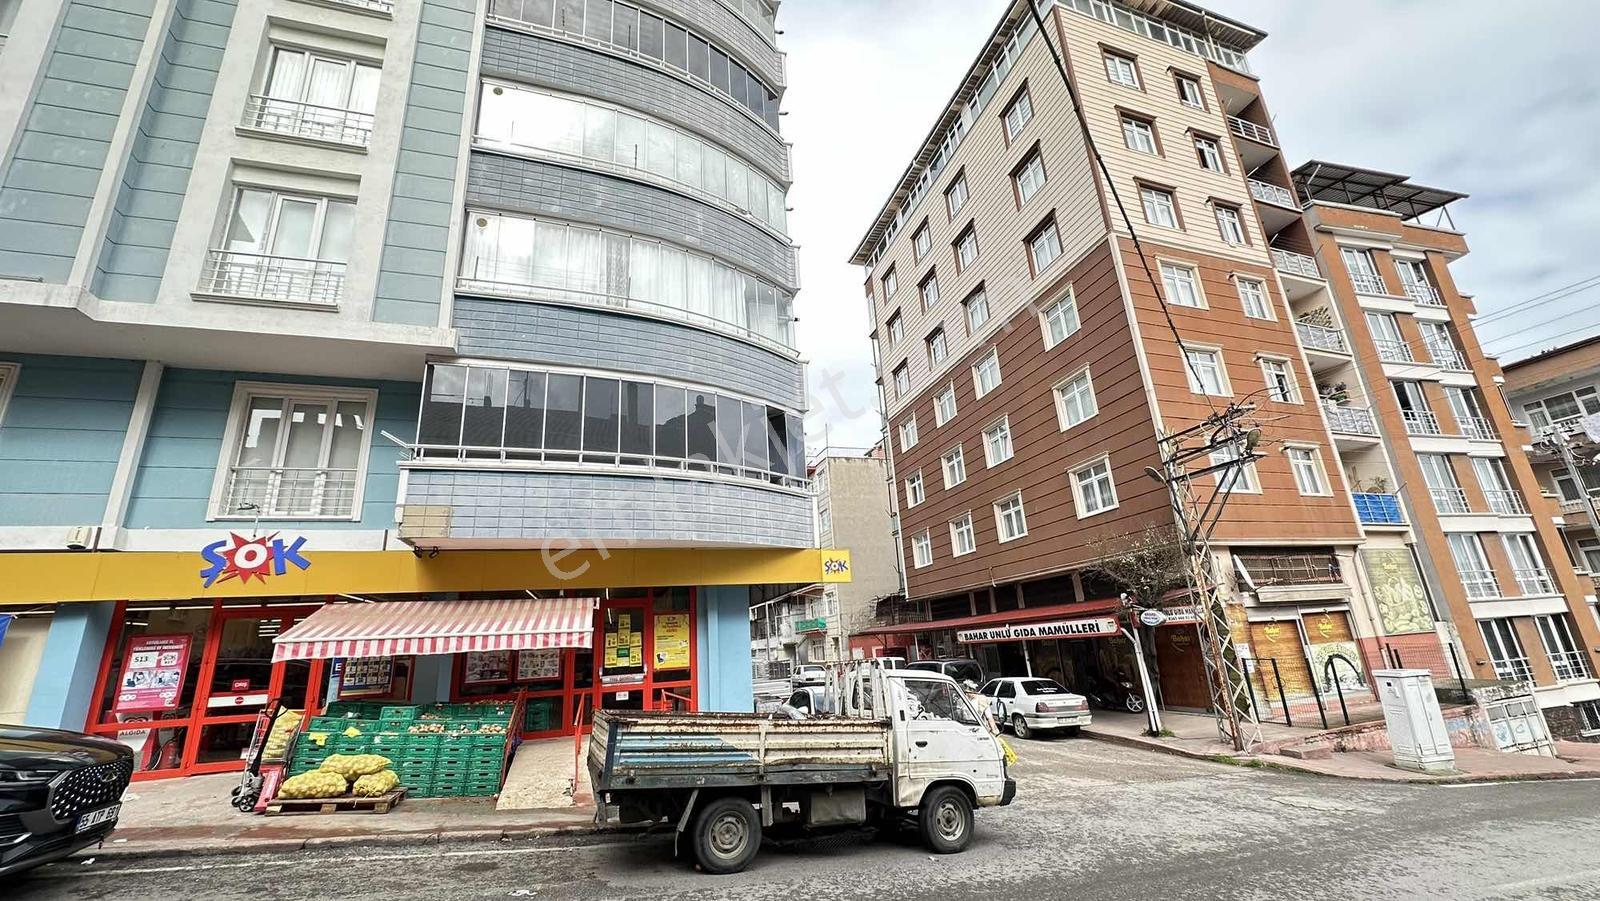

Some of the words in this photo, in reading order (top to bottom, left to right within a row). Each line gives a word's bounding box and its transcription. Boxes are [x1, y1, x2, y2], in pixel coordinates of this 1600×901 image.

[200, 534, 311, 588] ŞOK
[824, 559, 849, 575] ŞOK
[964, 630, 988, 641] BAHAR
[1013, 627, 1036, 638] GIDA
[1038, 619, 1100, 636] MAMÜLLERİ
[119, 728, 147, 737] ALGIDA
